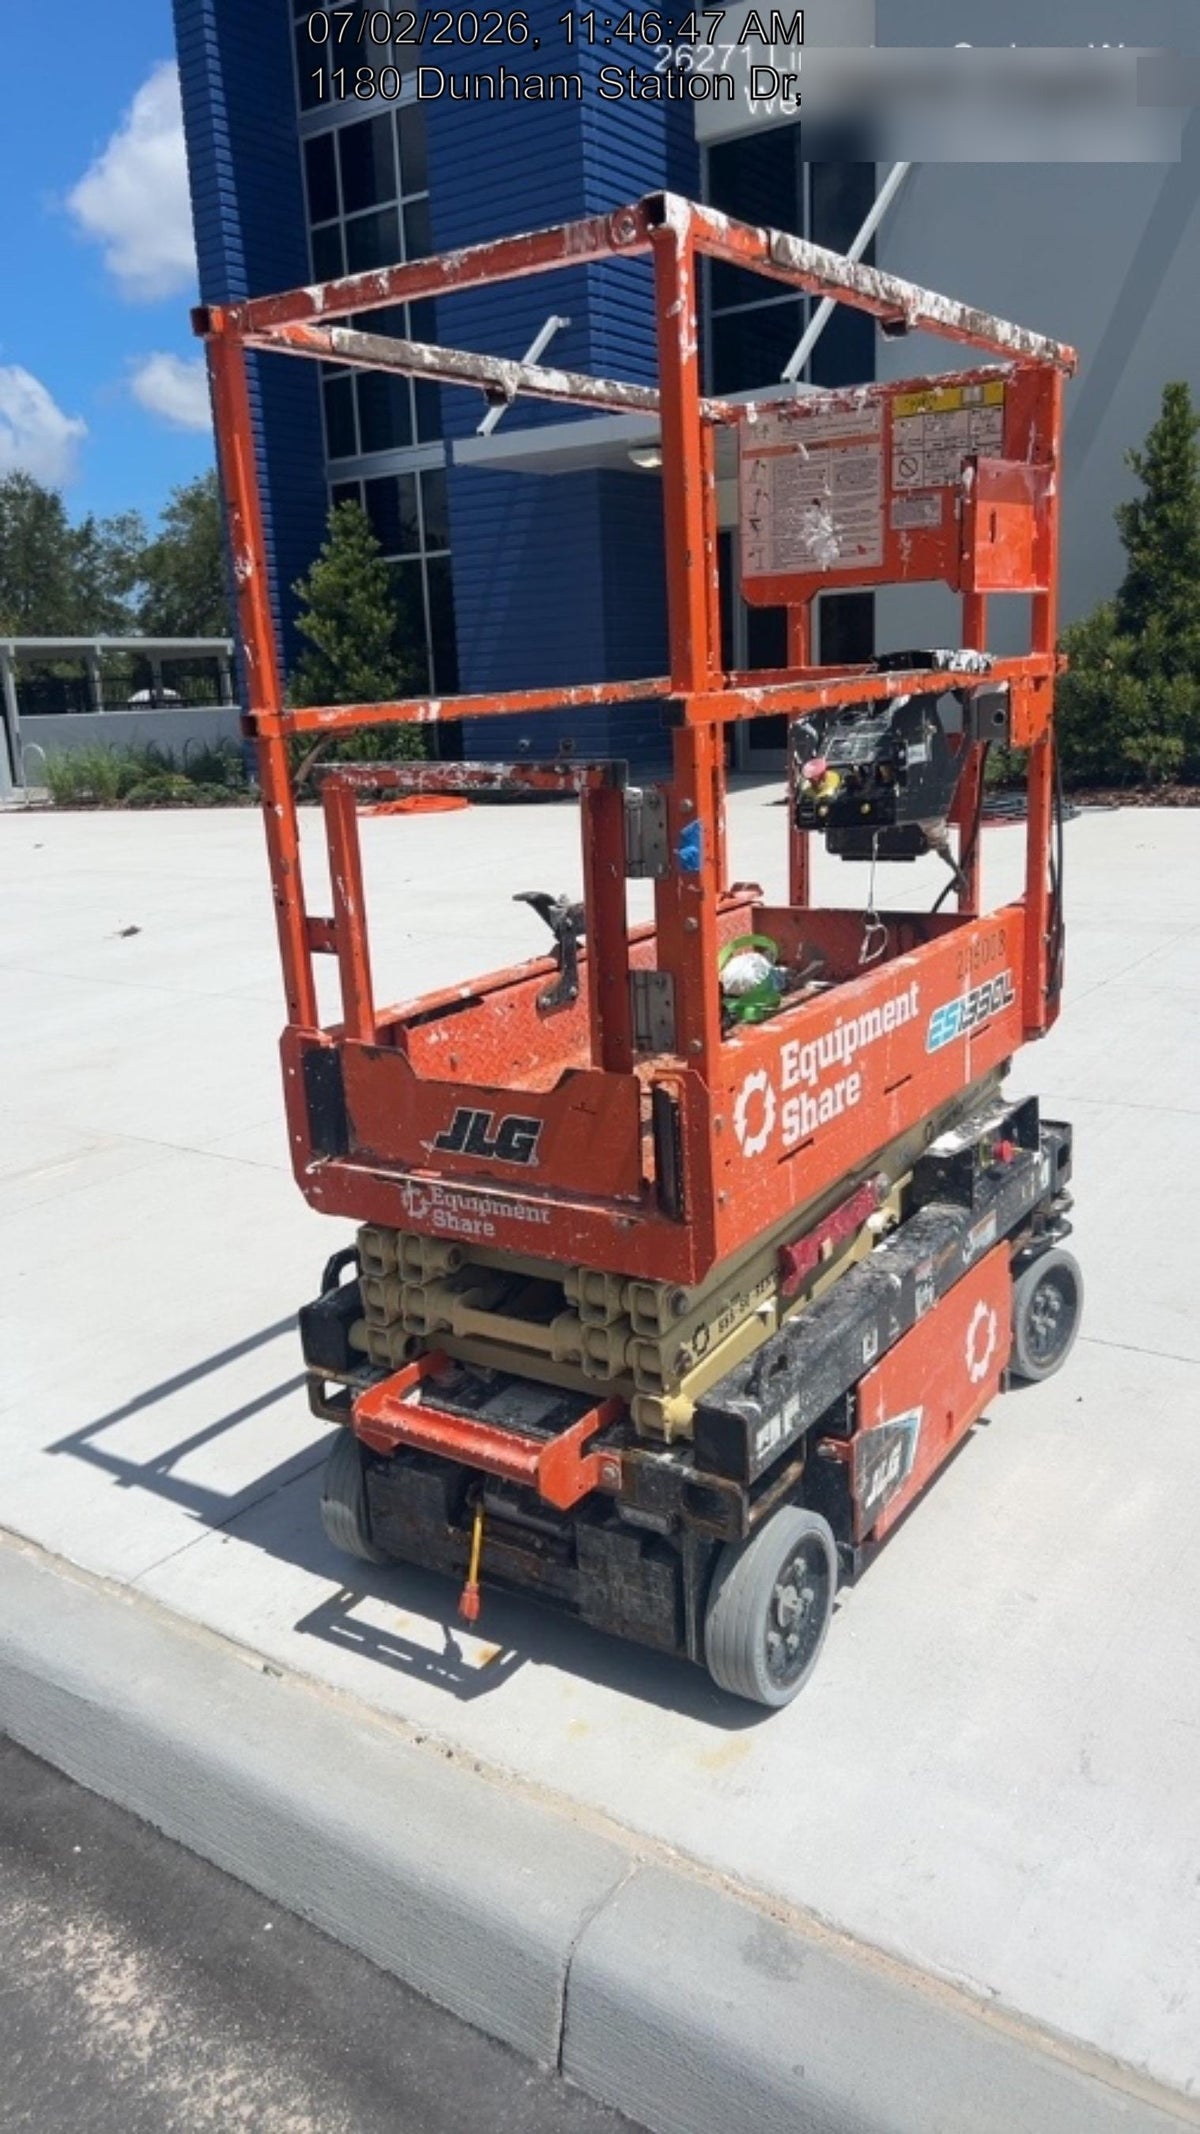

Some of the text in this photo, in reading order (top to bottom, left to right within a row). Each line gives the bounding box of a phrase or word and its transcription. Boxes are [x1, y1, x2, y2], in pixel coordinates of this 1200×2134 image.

[779, 980, 920, 1092] Equipment
[431, 1106, 544, 1166] JLG
[780, 1070, 862, 1148] Share
[429, 1184, 551, 1225] Equipment
[431, 1209, 496, 1237] Share
